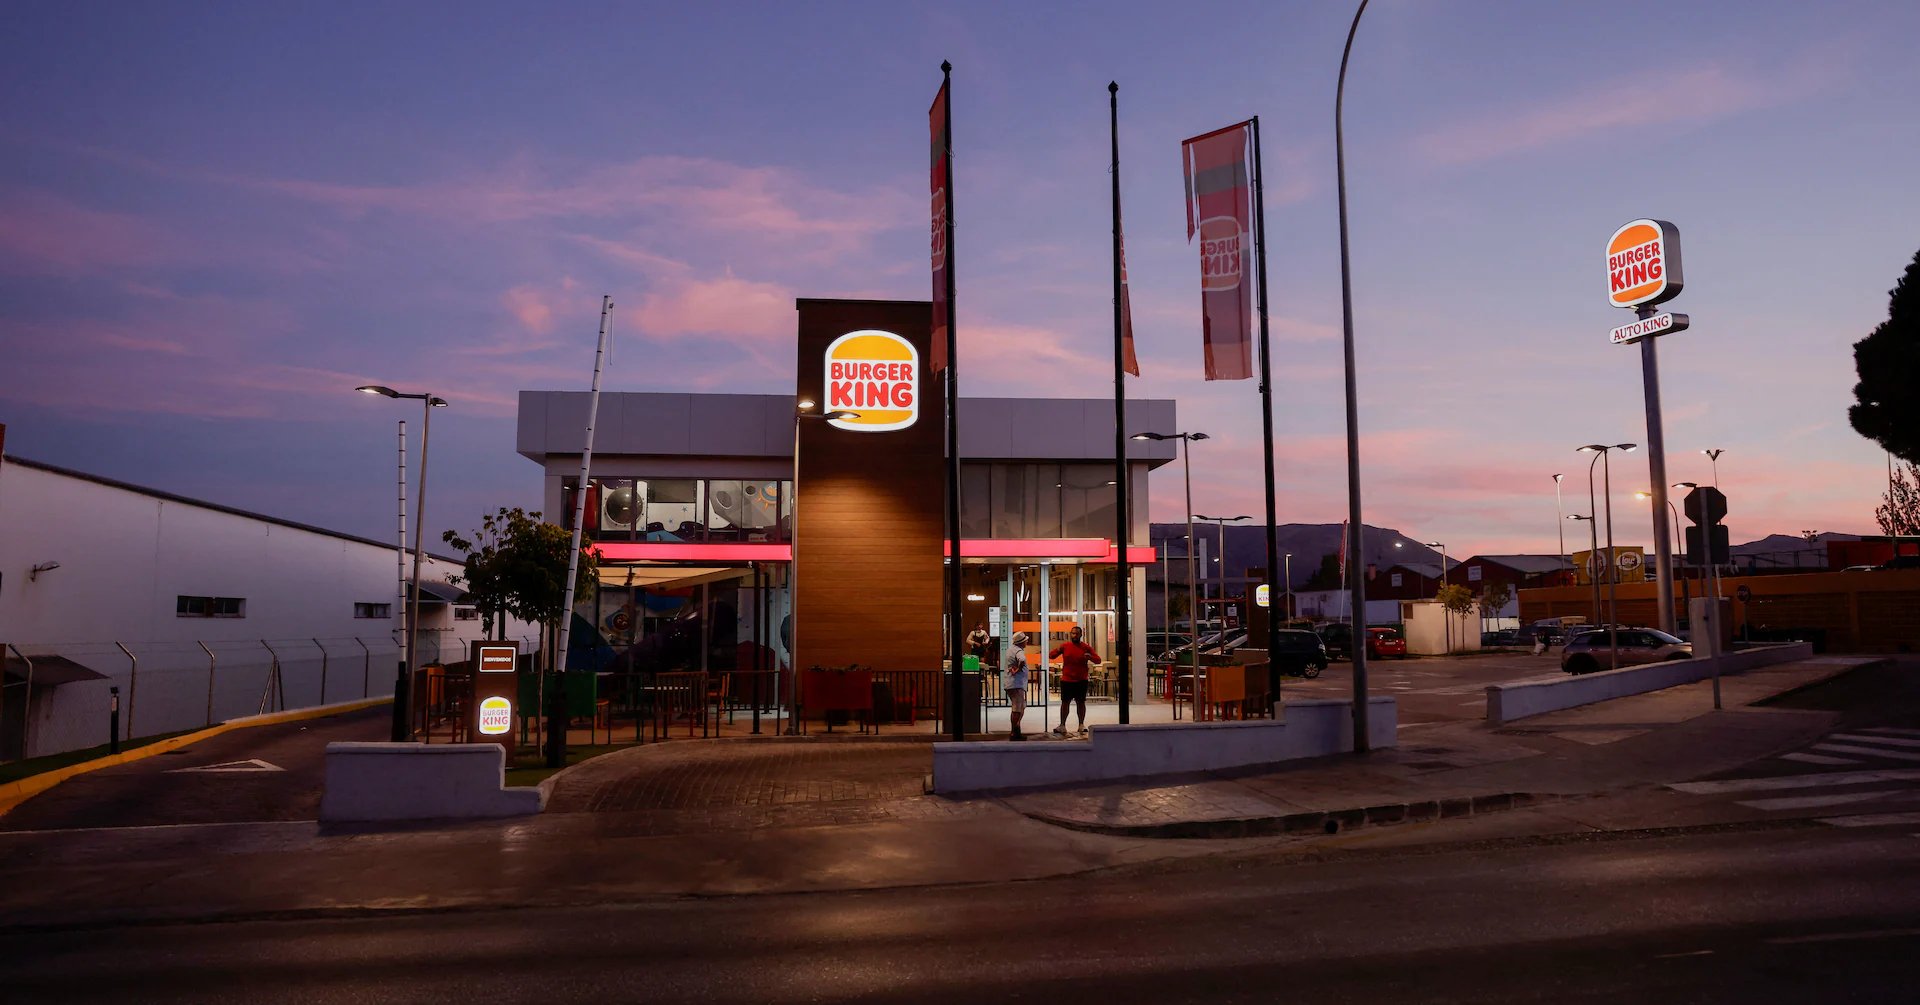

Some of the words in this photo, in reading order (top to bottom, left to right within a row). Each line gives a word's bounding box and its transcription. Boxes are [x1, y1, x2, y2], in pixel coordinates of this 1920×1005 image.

[1609, 241, 1661, 271] BURGER
[1610, 257, 1663, 292] KING
[1613, 323, 1642, 341] AUTO
[1643, 315, 1669, 333] KING
[831, 362, 913, 381] BURGER
[831, 381, 913, 408] KING
[482, 716, 509, 726] KING
